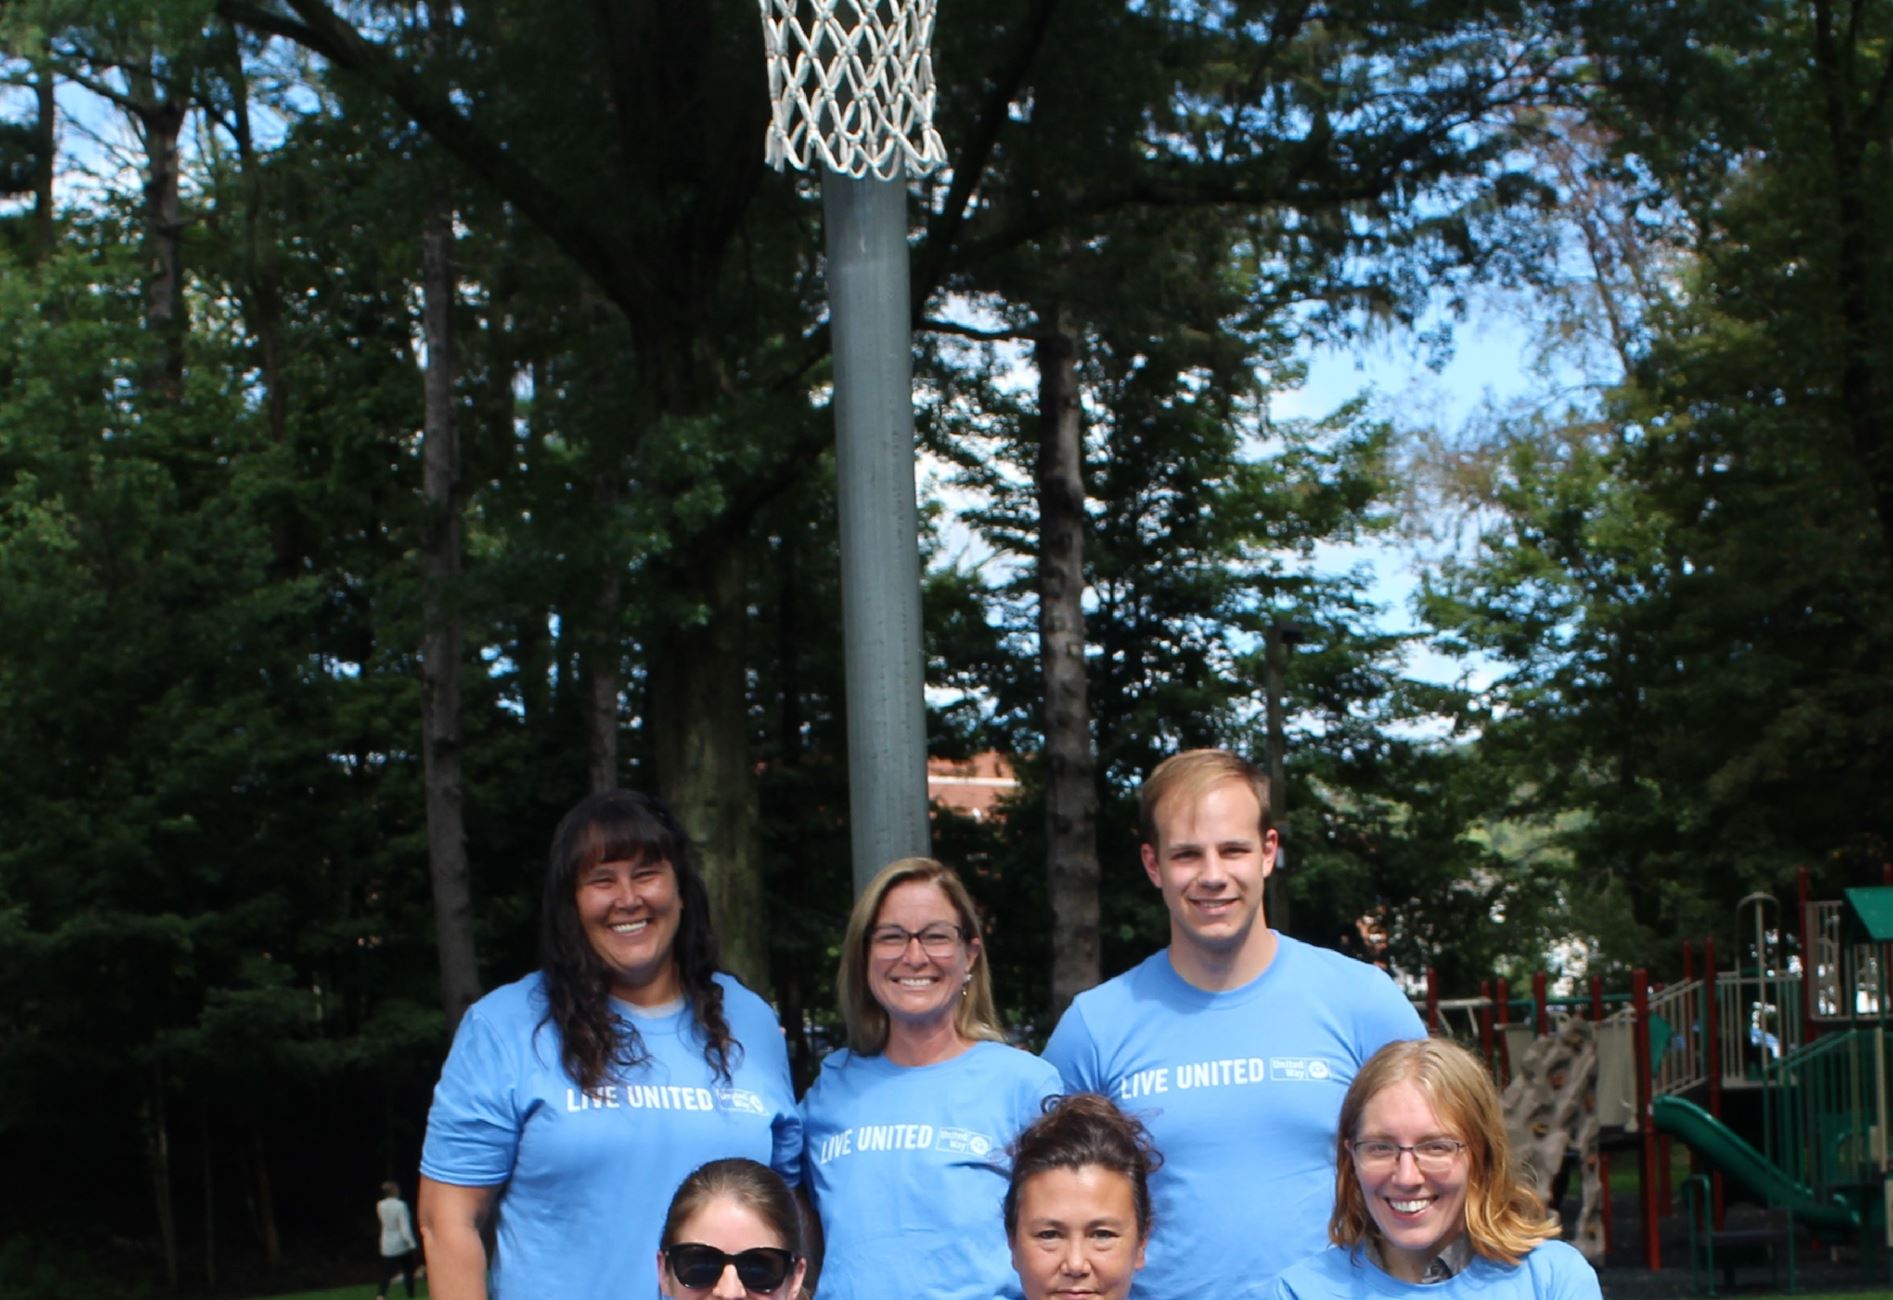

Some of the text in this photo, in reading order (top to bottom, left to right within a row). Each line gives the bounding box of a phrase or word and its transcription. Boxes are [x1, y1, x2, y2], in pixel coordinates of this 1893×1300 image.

[627, 1085, 713, 1111] UNITED
[1121, 1058, 1264, 1099] LIVE UNITED
[821, 1124, 932, 1164] LIVE UNITED
